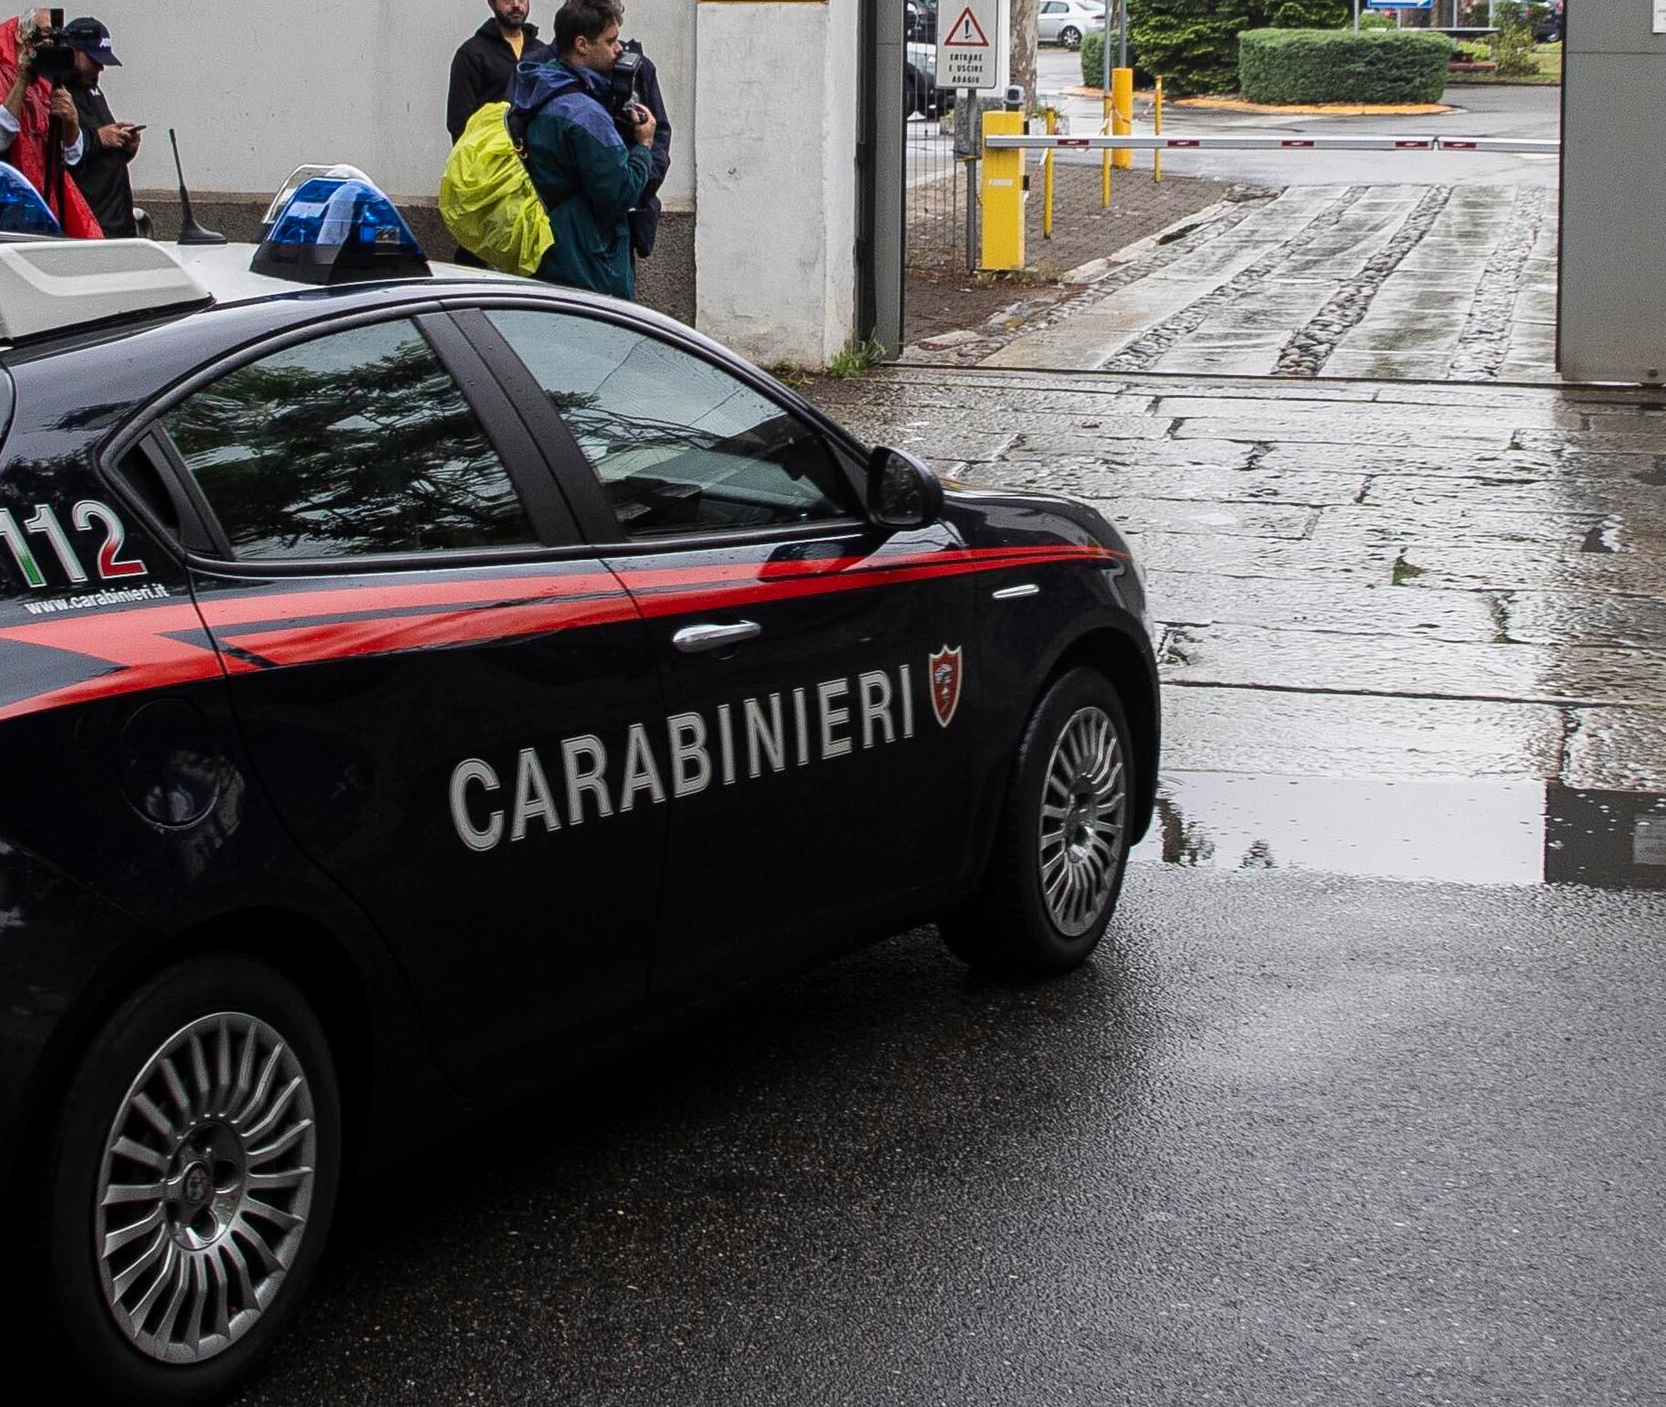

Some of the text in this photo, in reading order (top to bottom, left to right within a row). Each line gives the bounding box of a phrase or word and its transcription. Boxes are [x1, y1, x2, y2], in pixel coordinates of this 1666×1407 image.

[949, 53, 983, 62] ENTRARE
[956, 64, 983, 72] USCIRE
[951, 75, 980, 83] ADAGIO
[24, 582, 171, 615] www.carabinieri.it
[448, 664, 915, 853] CARABINIERI
